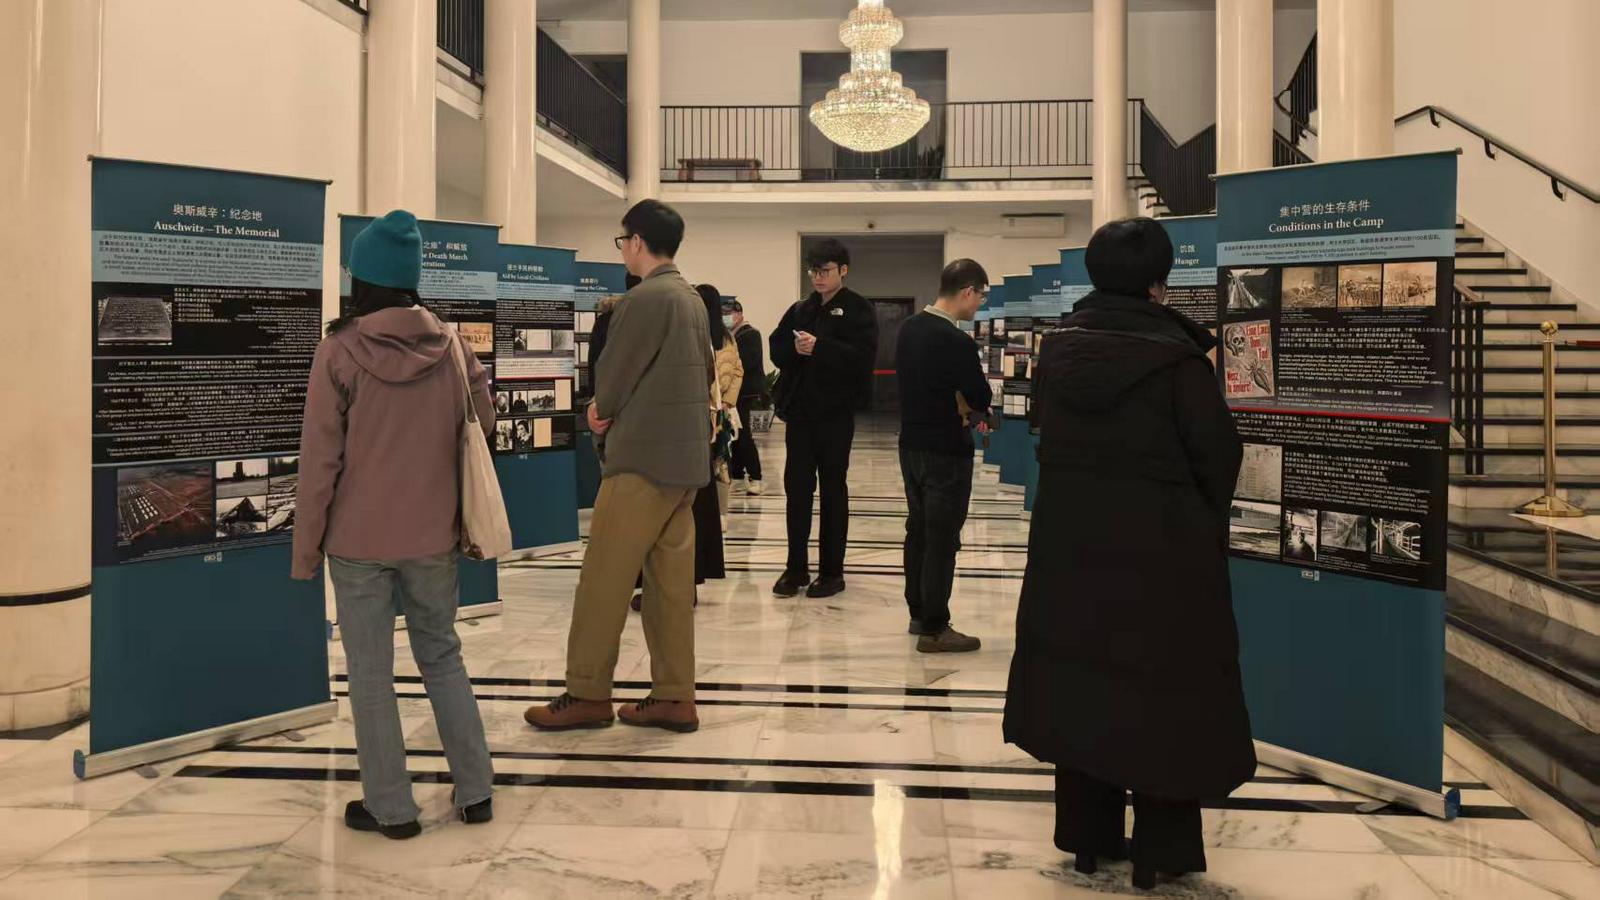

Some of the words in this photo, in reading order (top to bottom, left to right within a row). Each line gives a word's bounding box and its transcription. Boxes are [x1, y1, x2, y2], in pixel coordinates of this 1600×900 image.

[172, 204, 263, 222] 奥斯威辛：纪念地
[1279, 199, 1371, 218] 集中营的生存条件
[234, 225, 280, 238] Memorial
[1268, 221, 1322, 234] Conditions
[1323, 221, 1334, 231] in
[1335, 220, 1351, 231] the
[1352, 217, 1385, 231] Camp
[428, 252, 448, 260] Death
[448, 253, 468, 261] March
[1174, 257, 1200, 267] Hunger
